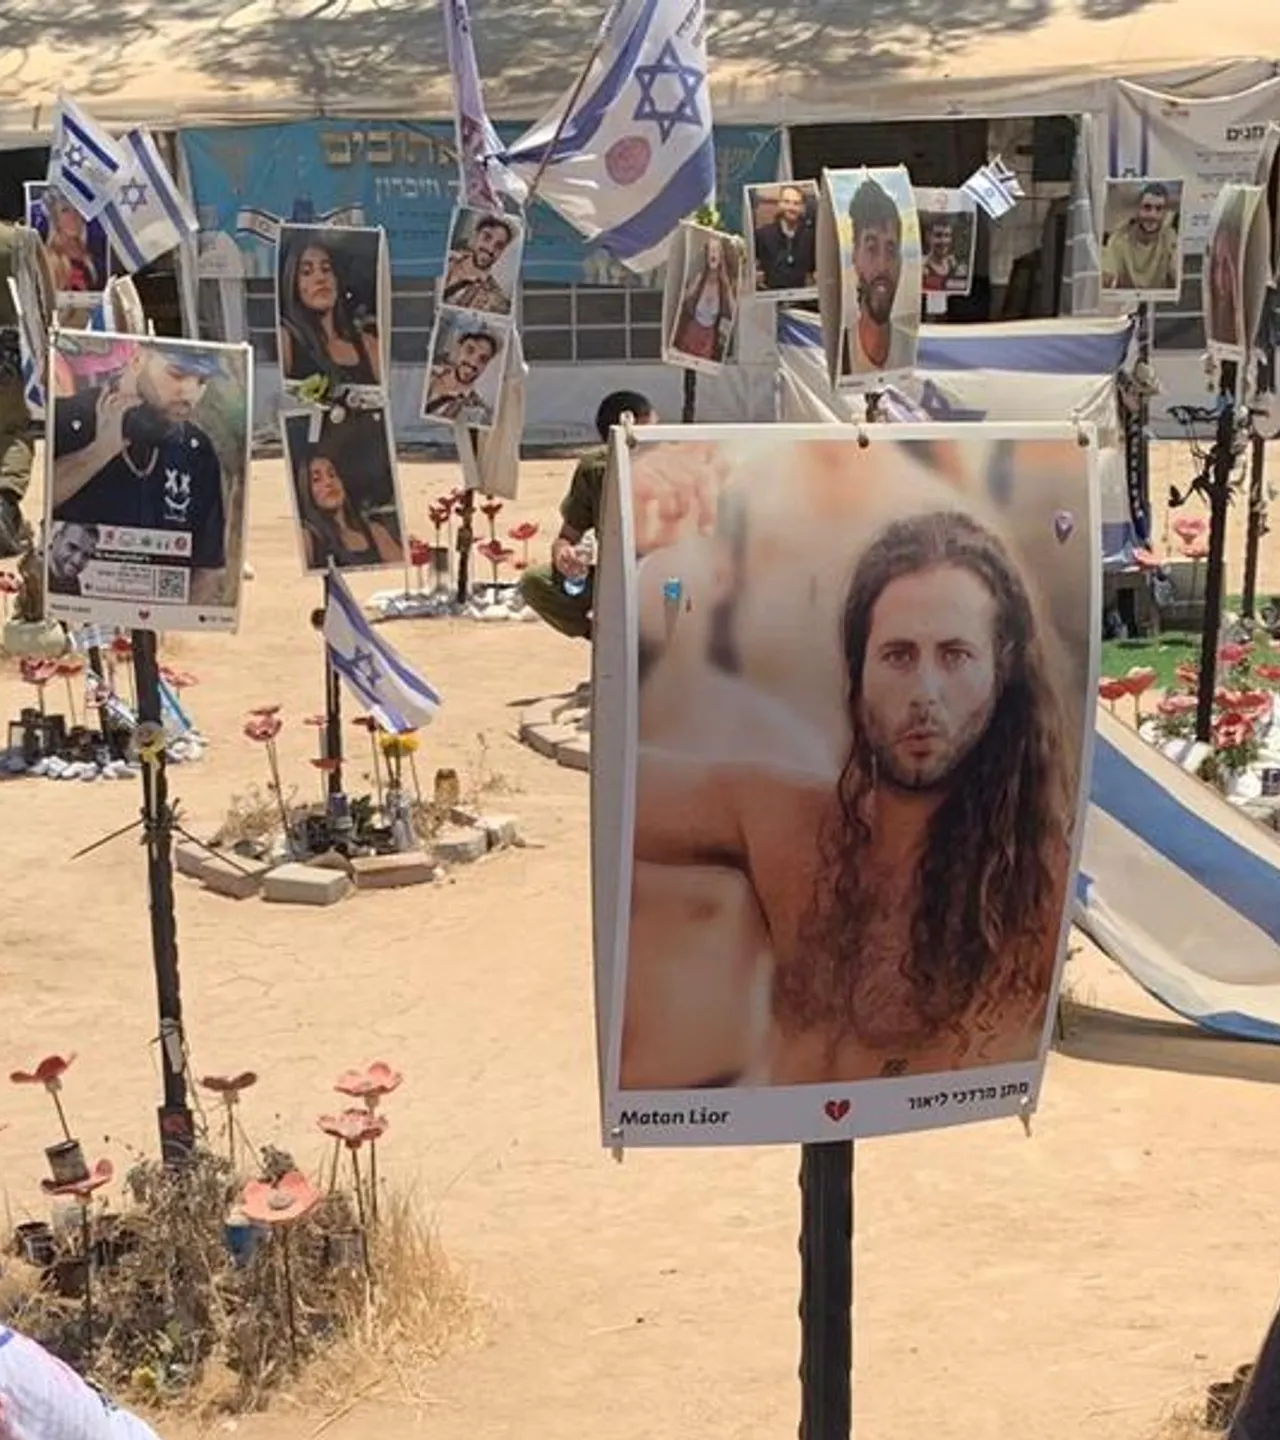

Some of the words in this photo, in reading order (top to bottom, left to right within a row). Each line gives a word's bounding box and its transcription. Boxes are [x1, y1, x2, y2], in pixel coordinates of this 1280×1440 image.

[952, 1086, 997, 1105] מרדכי
[999, 1081, 1030, 1100] מתן
[908, 1091, 949, 1110] ליאור
[619, 1108, 685, 1125] Matan
[689, 1105, 732, 1125] Lior
